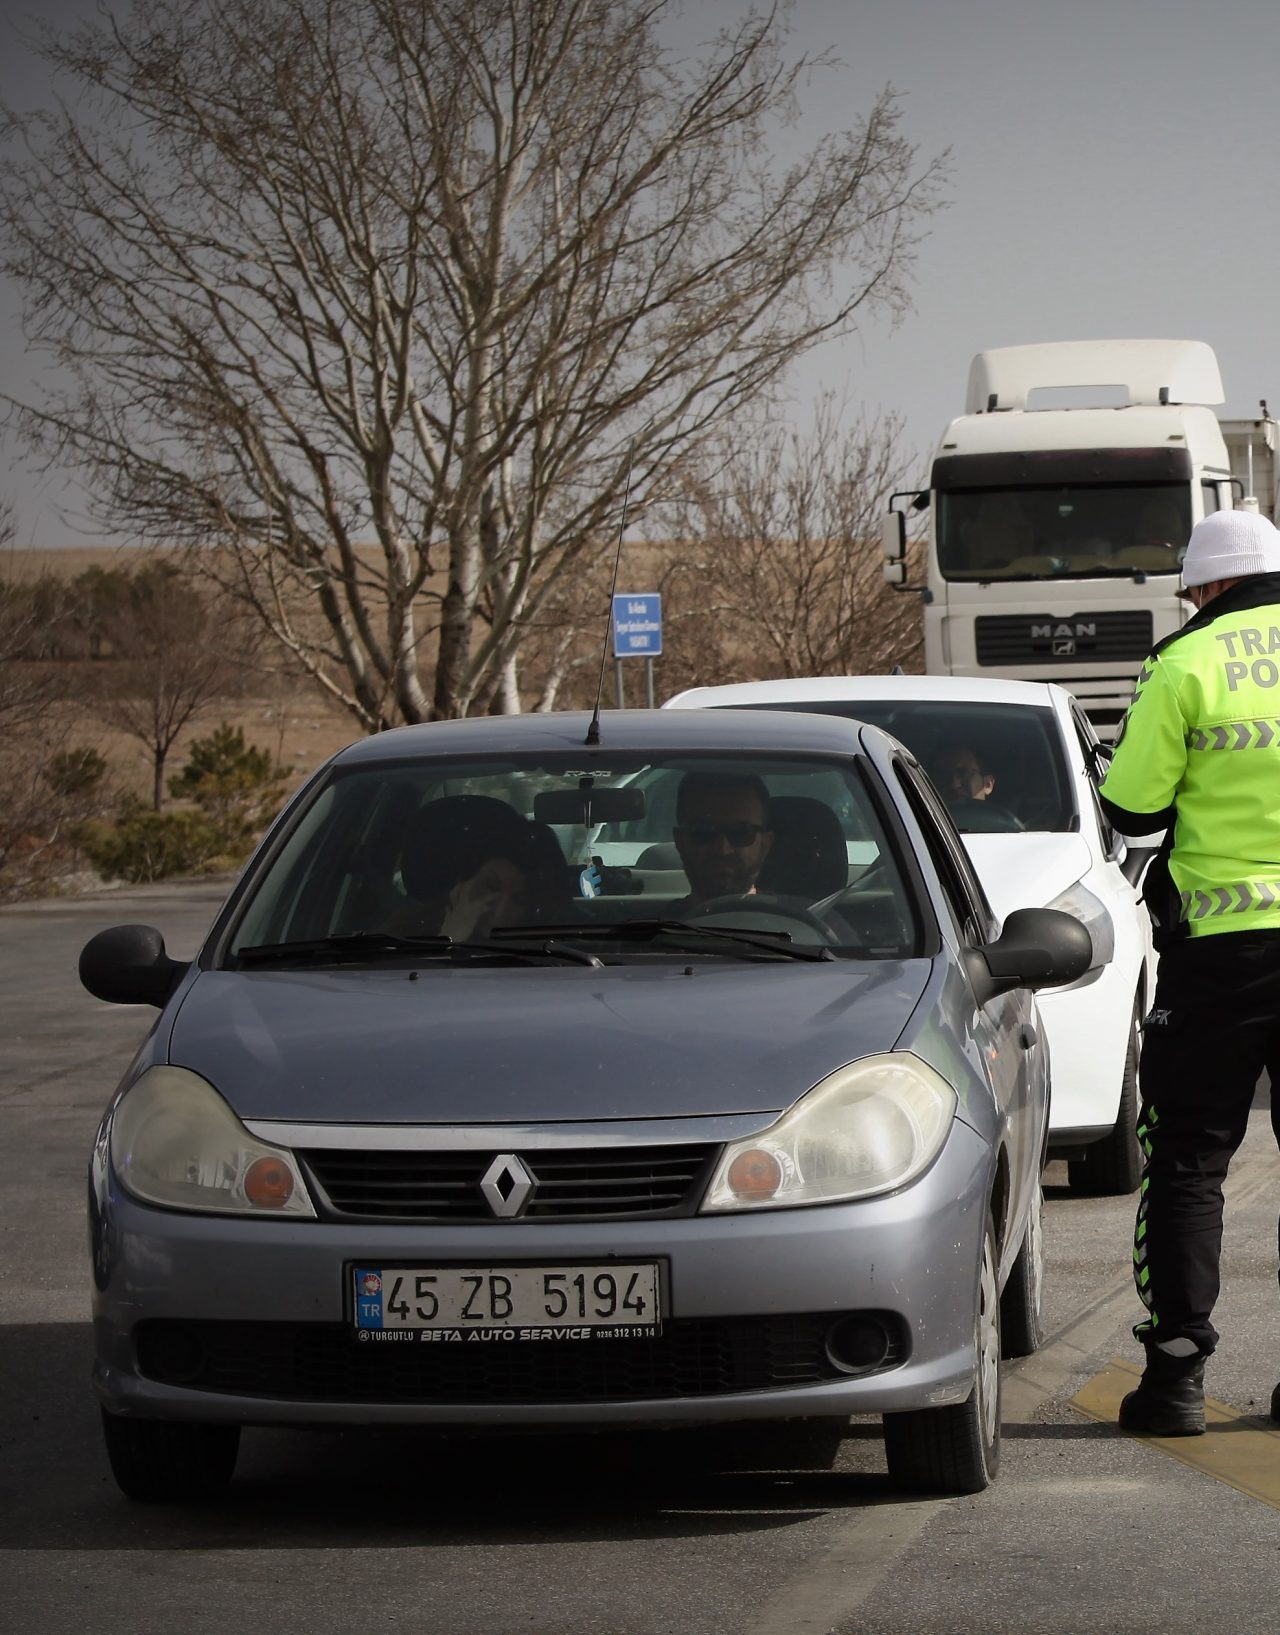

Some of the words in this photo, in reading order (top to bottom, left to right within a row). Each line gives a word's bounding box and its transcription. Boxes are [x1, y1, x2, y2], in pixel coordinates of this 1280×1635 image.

[1032, 624, 1096, 638] MAN
[388, 1276, 439, 1320] 45
[460, 1275, 513, 1320] ZB
[543, 1272, 647, 1318] 5194
[361, 1303, 380, 1317] TR
[370, 1331, 414, 1341] TURGUTLU
[420, 1330, 463, 1342] BETA
[467, 1329, 515, 1341] AUTO
[519, 1328, 592, 1340] SERVICE
[614, 1328, 629, 1338] 312
[632, 1327, 642, 1337] 13
[645, 1327, 655, 1337] 14
